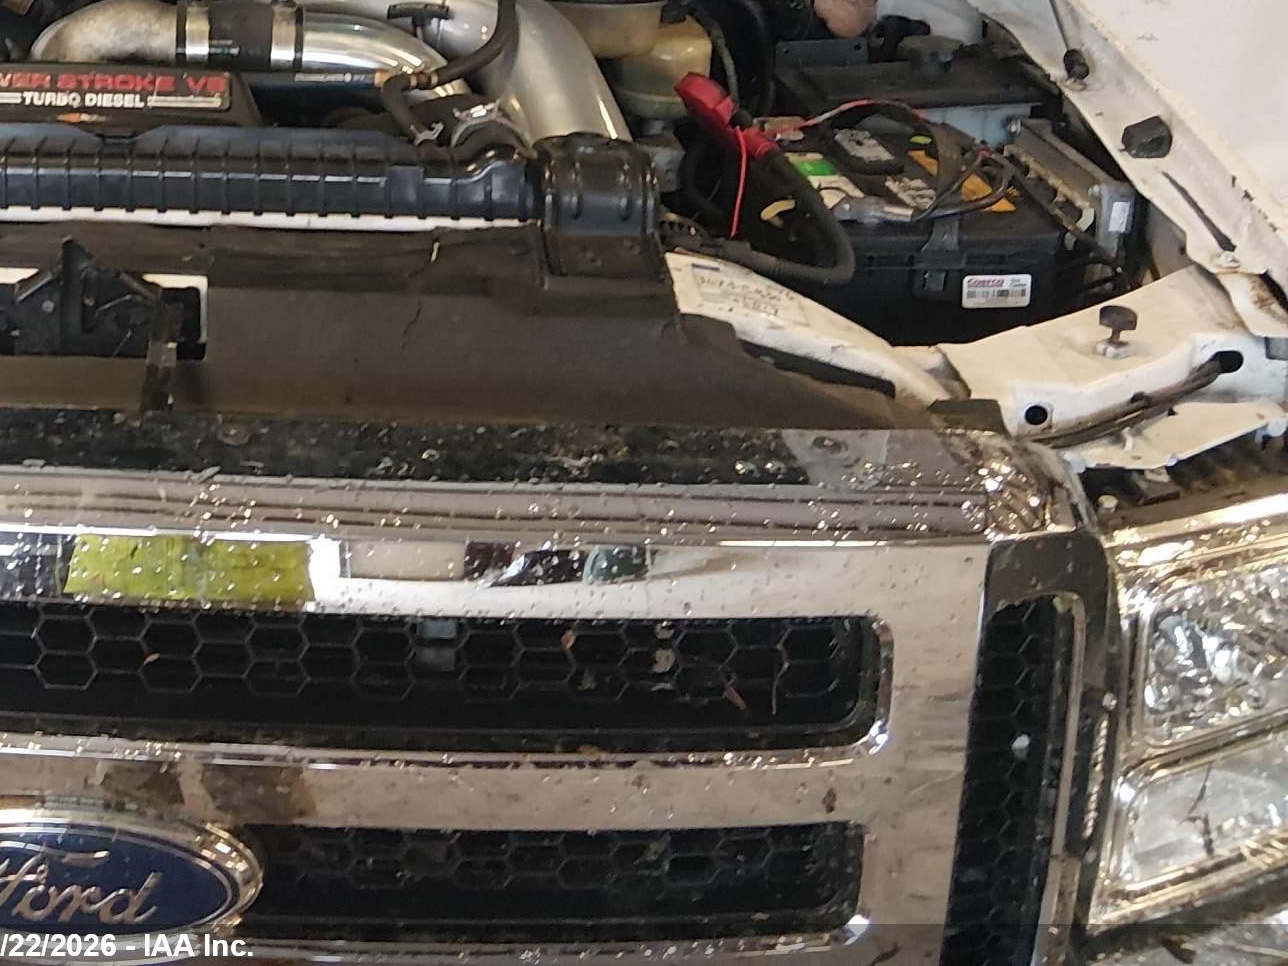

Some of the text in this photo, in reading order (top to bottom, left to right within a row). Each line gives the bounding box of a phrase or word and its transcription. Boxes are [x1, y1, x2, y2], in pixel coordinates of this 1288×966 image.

[56, 72, 176, 92] STROKE
[186, 74, 228, 93] V8
[21, 90, 145, 109] TURBO DIESEL
